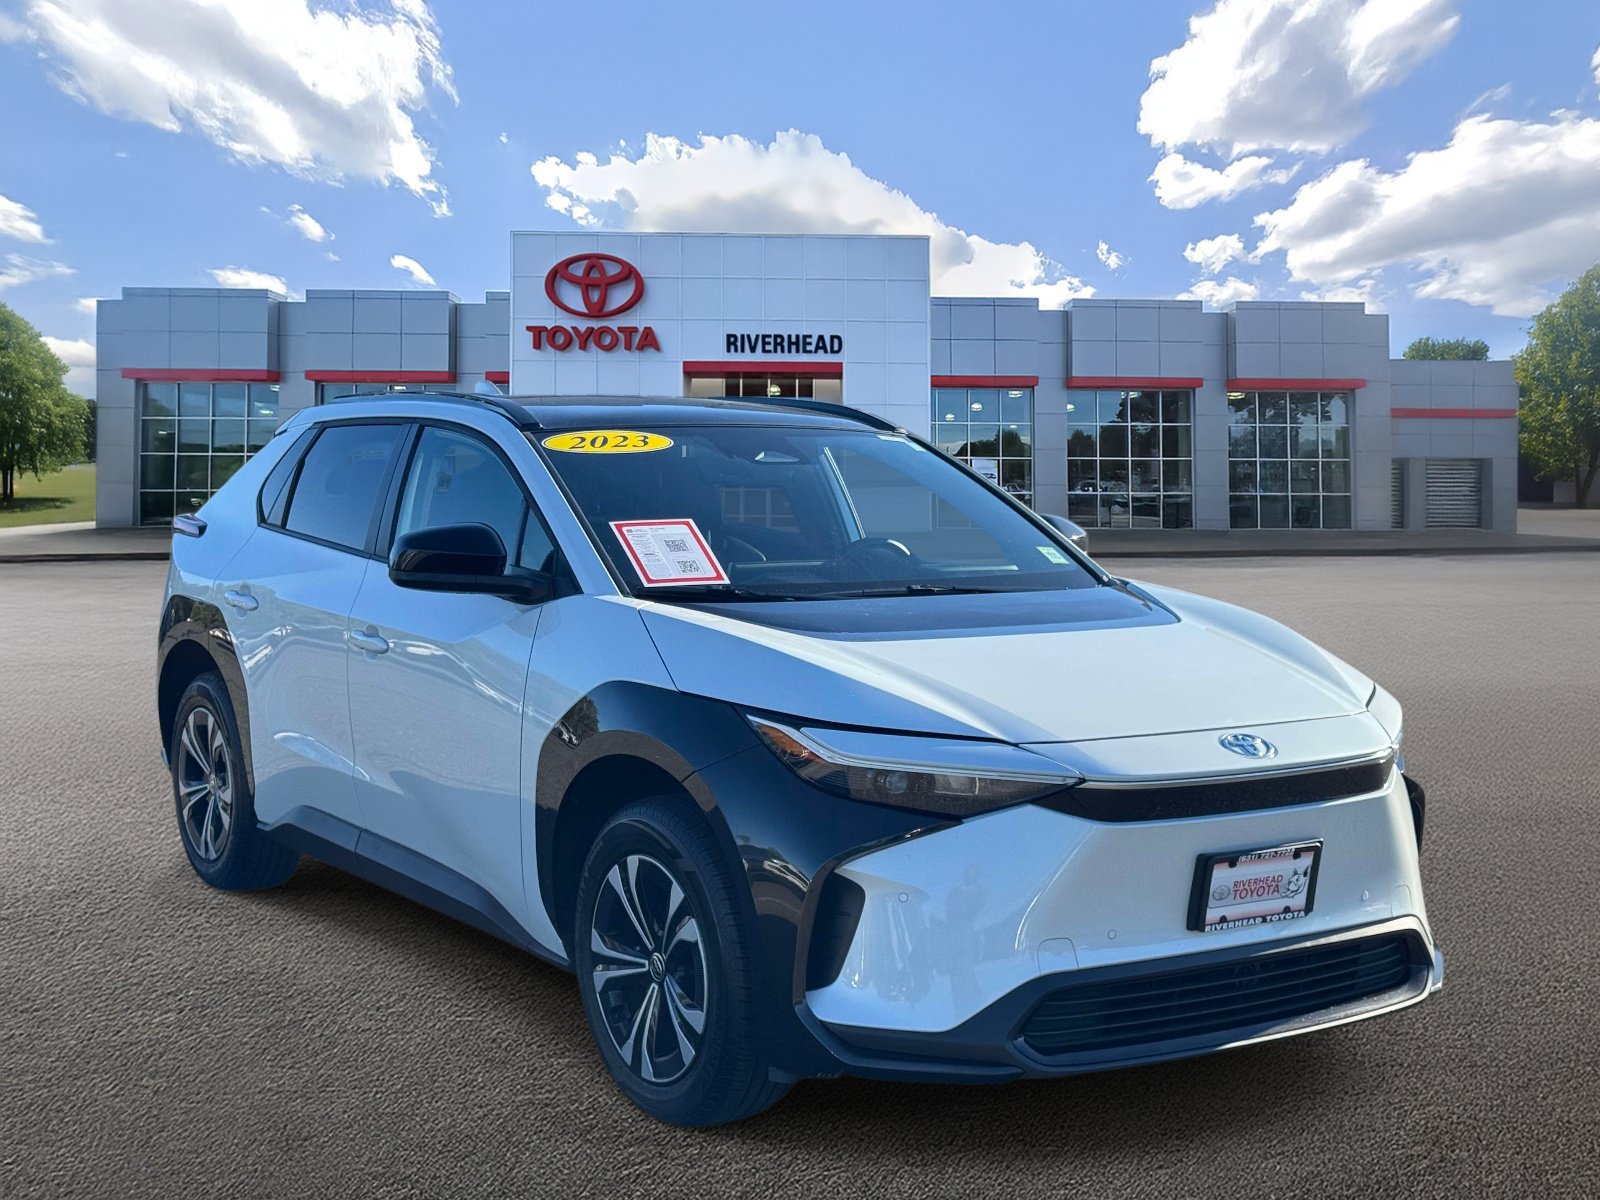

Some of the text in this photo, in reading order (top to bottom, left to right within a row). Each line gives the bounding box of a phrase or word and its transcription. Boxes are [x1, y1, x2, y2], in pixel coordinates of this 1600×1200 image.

[525, 325, 661, 352] TOYOTA
[726, 333, 843, 355] RIVERHEAD
[568, 435, 649, 450] 2023
[1233, 874, 1284, 889] RIVERHEAD
[1232, 884, 1281, 901] TOYOTA
[1204, 910, 1306, 933] RIVERHEAD TOYOTA
